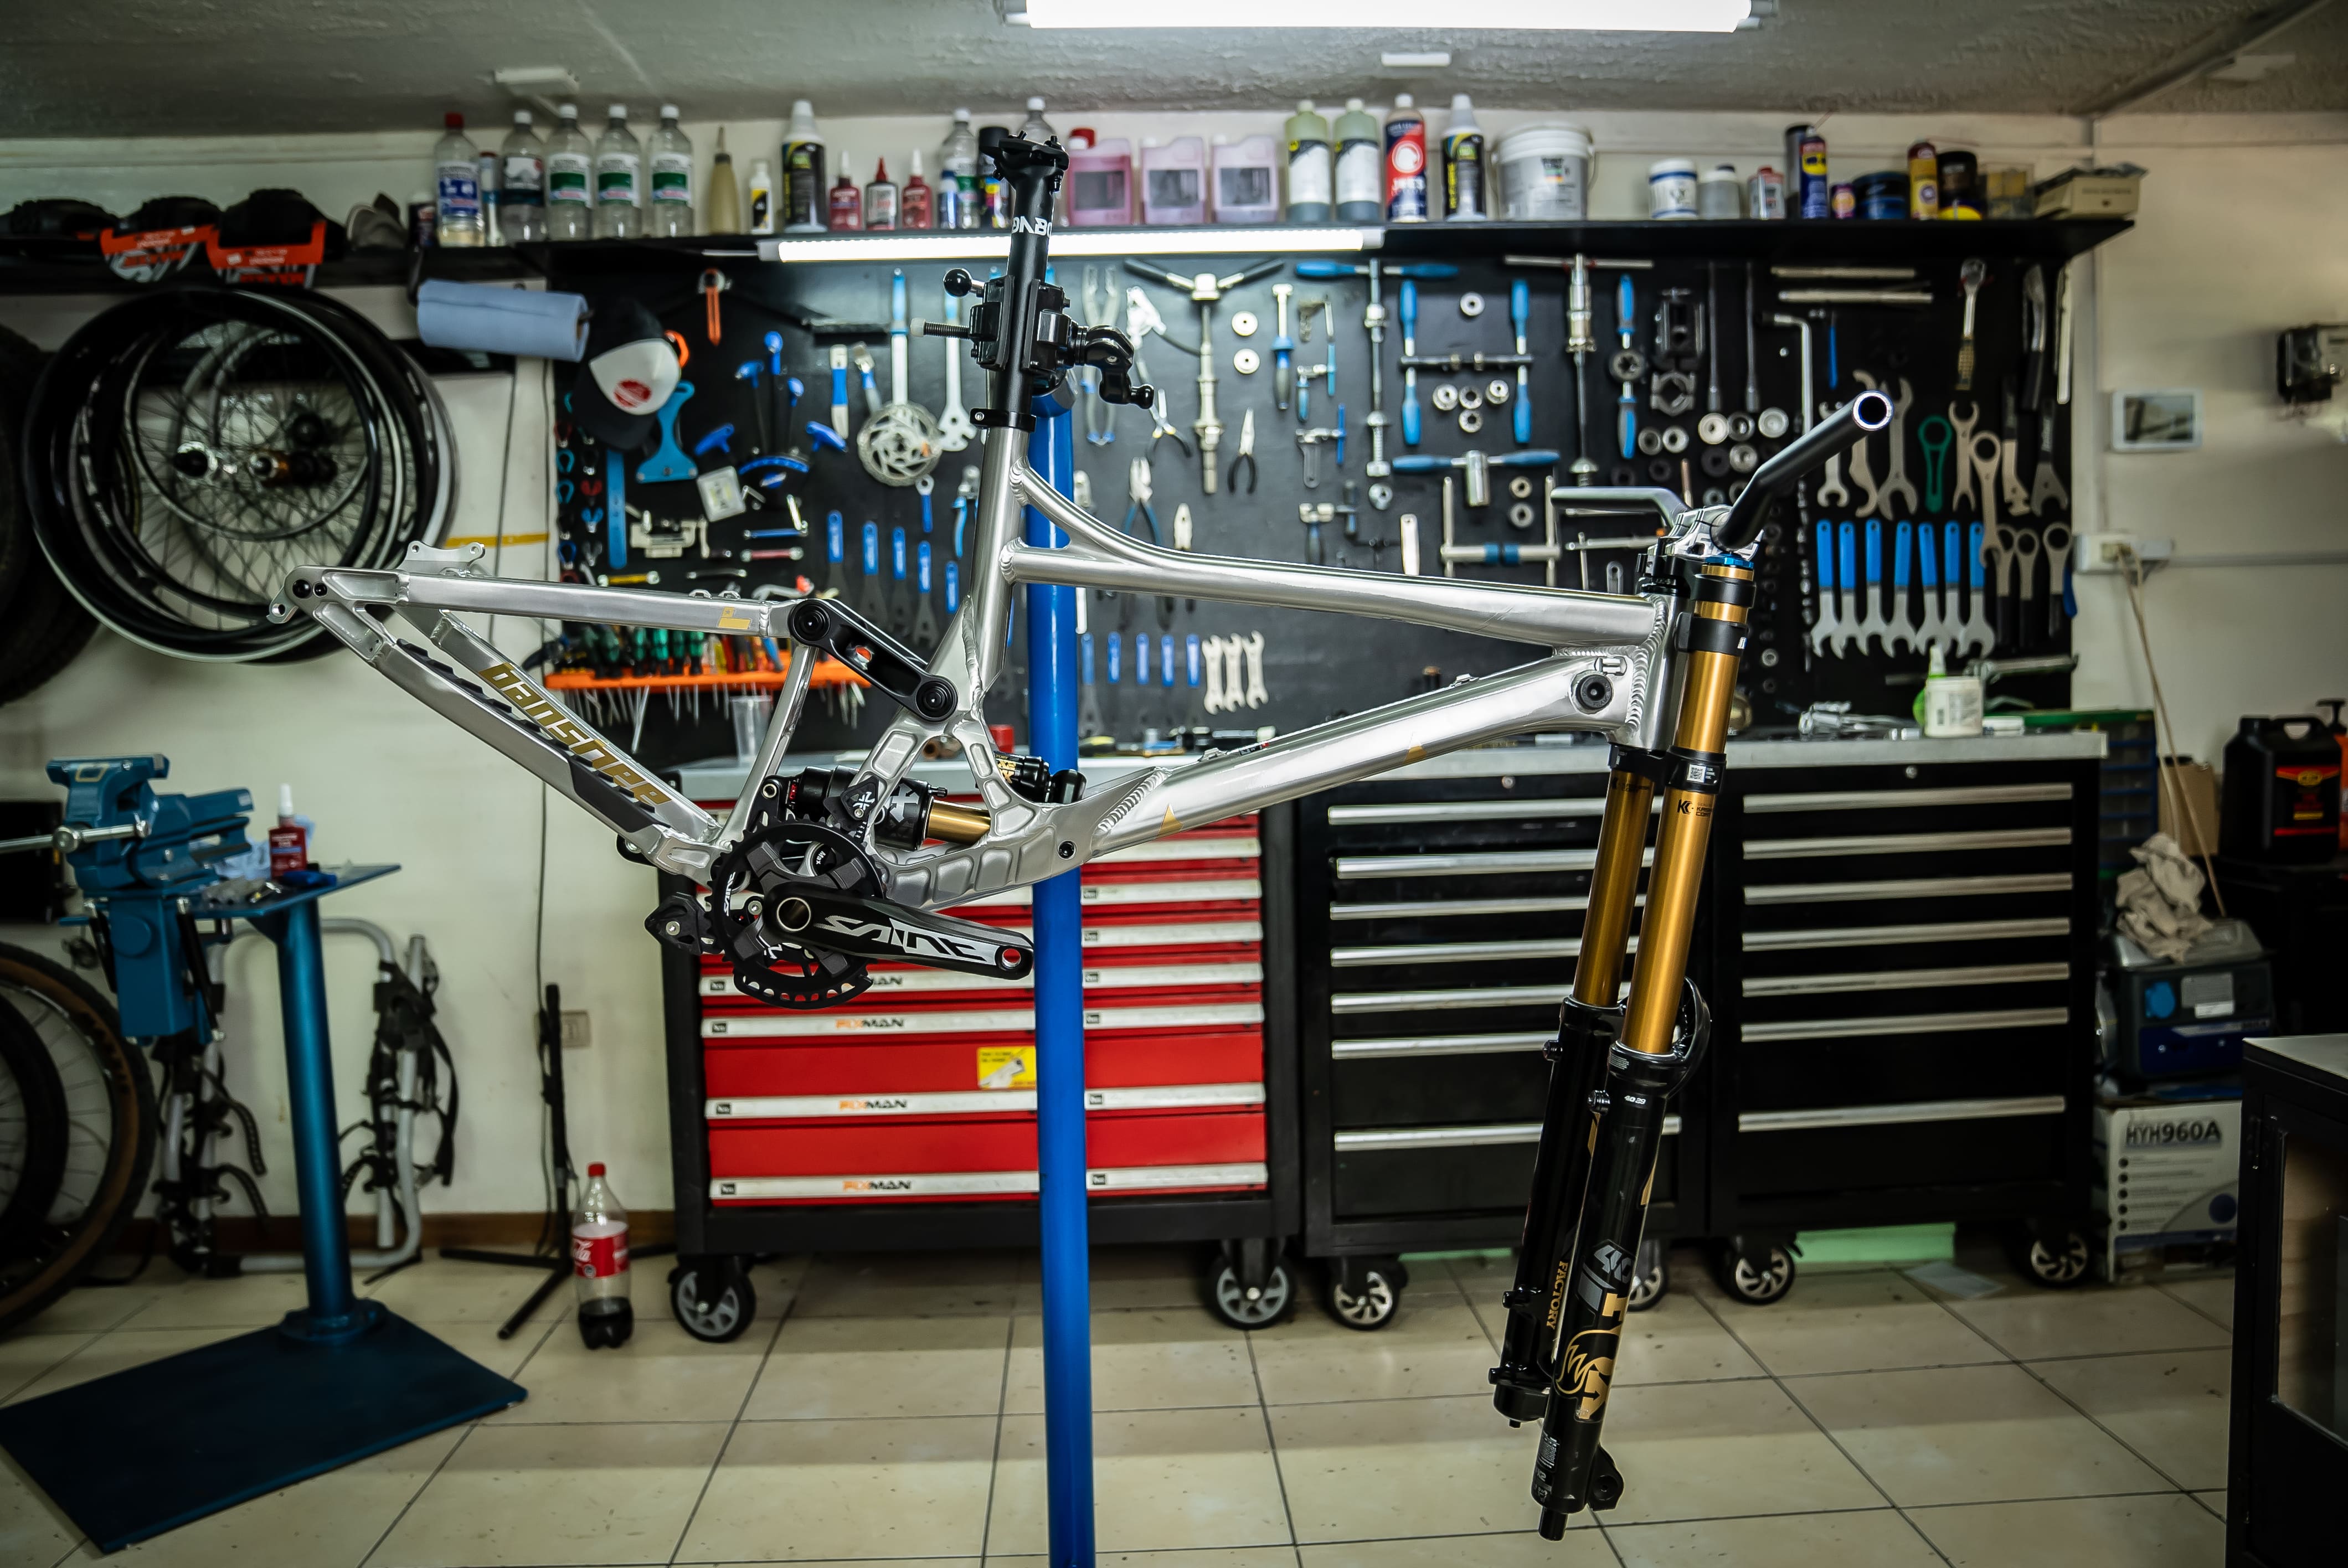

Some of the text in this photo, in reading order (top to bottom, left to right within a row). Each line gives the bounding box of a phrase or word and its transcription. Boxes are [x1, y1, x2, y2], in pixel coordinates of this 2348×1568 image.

[816, 850, 826, 865] Max
[2125, 1120, 2222, 1144] HYH960A
[1546, 1261, 1569, 1330] FACTORY
